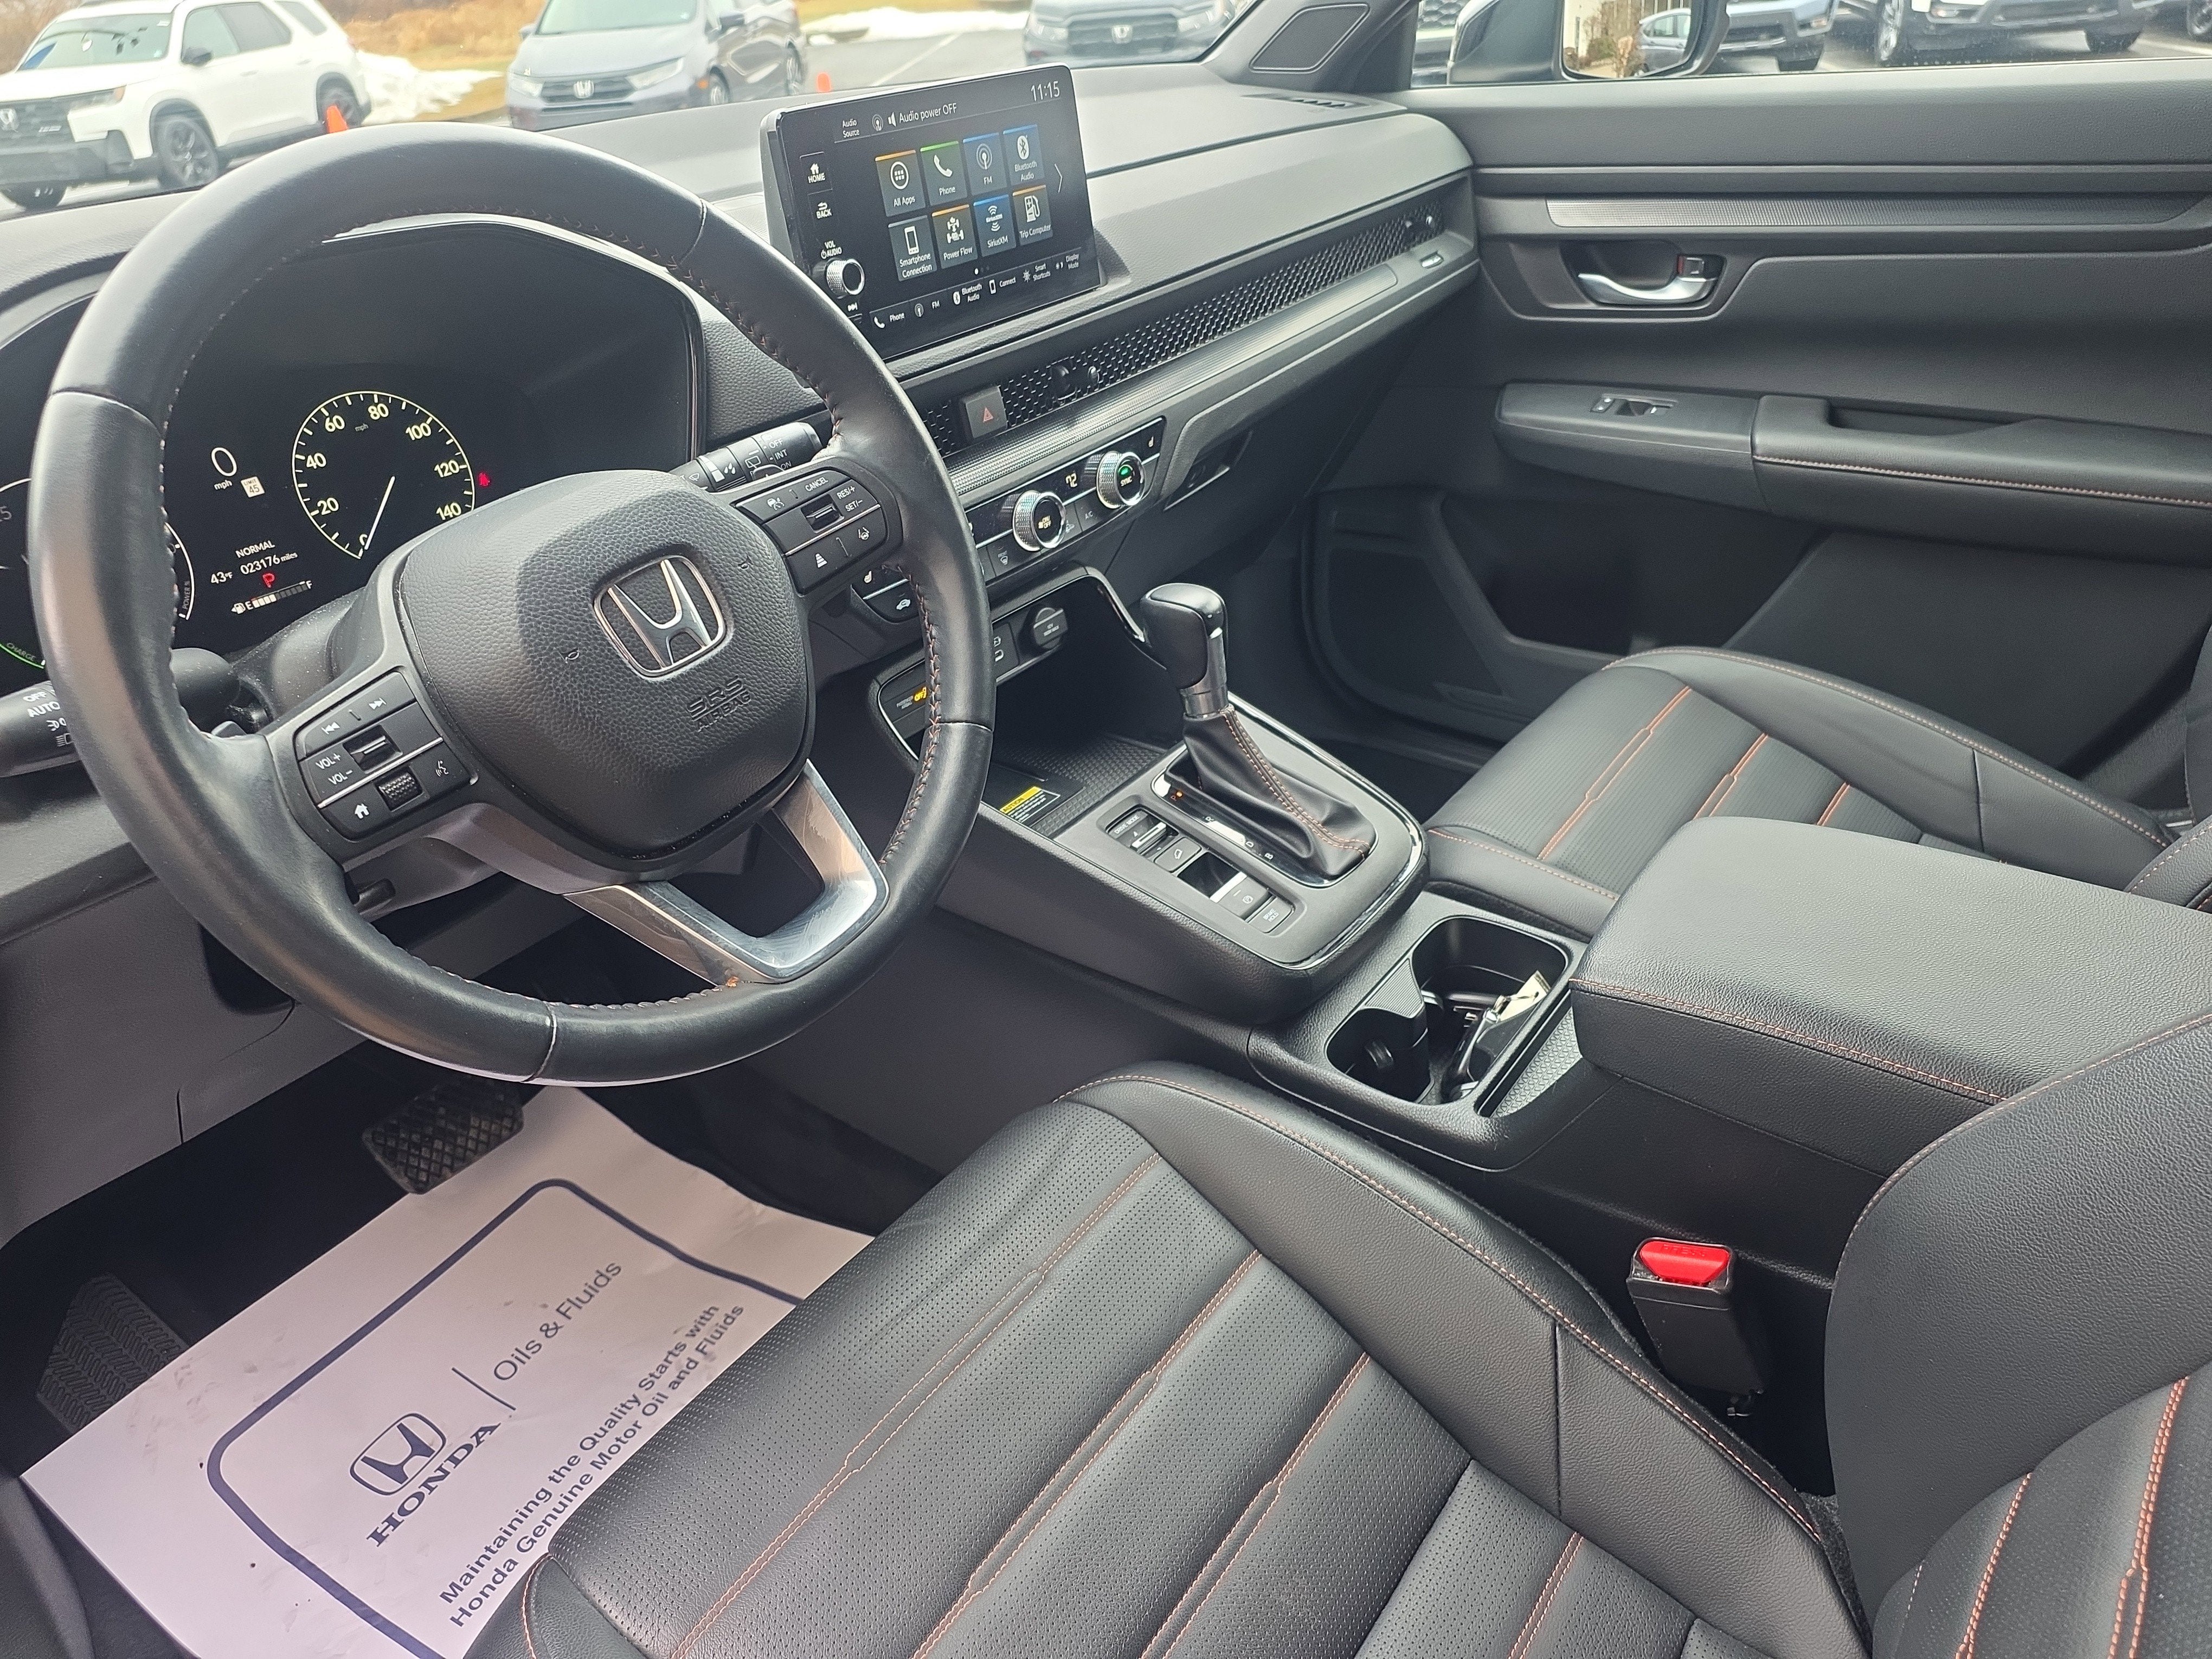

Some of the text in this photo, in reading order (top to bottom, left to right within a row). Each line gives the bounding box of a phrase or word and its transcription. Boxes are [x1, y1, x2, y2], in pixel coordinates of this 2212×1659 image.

[1031, 81, 1060, 102] 11:15
[899, 102, 957, 124] Audio power OFF
[843, 119, 857, 128] Audio
[843, 128, 860, 138] Source
[808, 172, 826, 183] HOME
[983, 176, 993, 185] FM
[1021, 172, 1034, 182] Audio
[939, 186, 956, 196] Phone
[893, 196, 916, 207] All Apps
[816, 208, 832, 219] BACK
[1019, 224, 1051, 238] Trip Computer
[825, 240, 835, 249] VOL
[987, 235, 1008, 248] SiriusXM
[827, 247, 842, 257] AUDIO
[943, 247, 973, 261] Power Flow
[899, 253, 931, 267] Smartphone
[902, 264, 933, 278] Connection
[931, 300, 940, 309] FM
[967, 293, 980, 303] Audio
[890, 312, 905, 322] Phone
[368, 403, 389, 420] 80
[325, 415, 345, 432] 60
[406, 422, 432, 440] 100
[768, 438, 783, 449] OFF
[306, 453, 327, 469] 40
[774, 449, 788, 460] INT
[211, 447, 237, 477] 0
[434, 460, 460, 478] 120
[781, 461, 792, 471] ON
[214, 479, 233, 491] mph
[243, 478, 257, 486] LIMIT
[805, 477, 829, 492] CANCEL
[1065, 473, 1078, 487] 72
[249, 484, 260, 494] 45
[837, 486, 856, 499] RES/+
[317, 497, 339, 515] 20
[436, 502, 461, 520] 140
[235, 539, 275, 558] NORMAL
[240, 554, 280, 575] 023176
[262, 573, 275, 588] P
[306, 580, 312, 589] F
[245, 601, 254, 610] E
[6, 642, 36, 661] CHARGE
[23, 691, 48, 703] OFF
[685, 676, 743, 718] SRS
[27, 701, 61, 718] AUTO
[316, 753, 342, 770] VOL+
[1002, 798, 1024, 812] AUTION
[1114, 824, 1129, 834] DRIVE
[494, 1262, 621, 1380] Oils & Fluids
[439, 1306, 719, 1604] Maintaining the Quality Starts with
[449, 1306, 744, 1627] Honda Genuine Motor Oil and Fluids
[366, 1423, 501, 1547] HONDA
